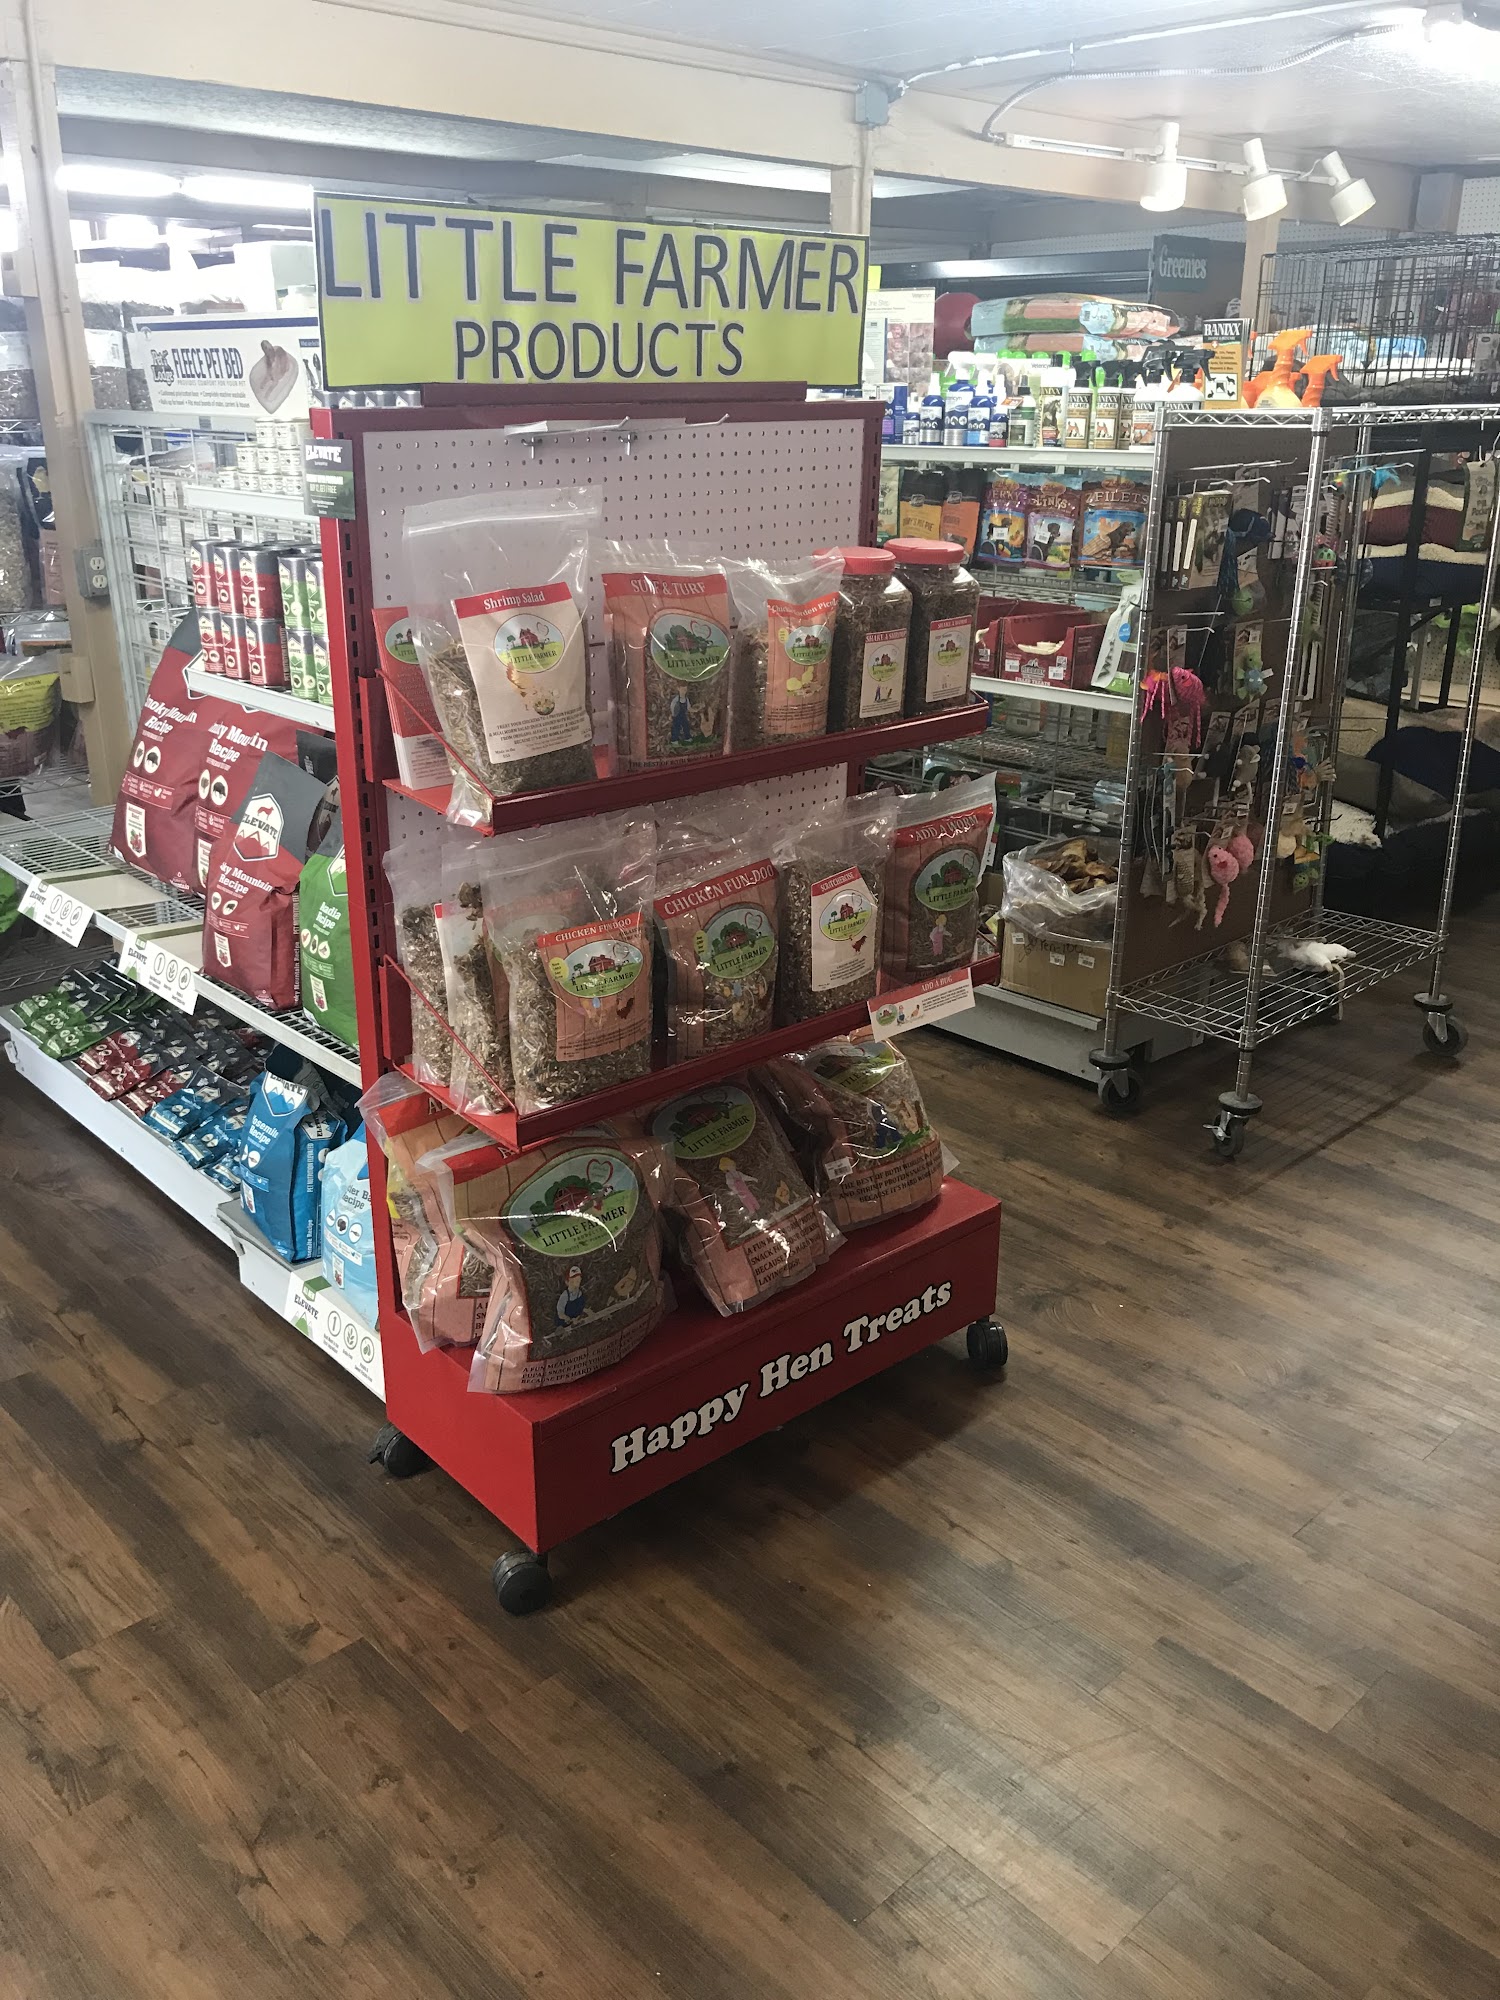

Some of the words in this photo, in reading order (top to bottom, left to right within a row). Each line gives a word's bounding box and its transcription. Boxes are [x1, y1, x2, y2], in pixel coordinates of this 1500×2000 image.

[321, 208, 577, 302] LITTLE
[615, 228, 860, 315] FARMER
[1159, 244, 1207, 279] Greenies
[1203, 322, 1241, 336] BANIXX
[455, 320, 744, 381] PRODUCTS
[171, 348, 206, 379] FLEECE
[206, 347, 224, 379] PET
[223, 347, 244, 379] BED
[662, 582, 672, 595] &
[672, 582, 706, 596] TURF
[483, 596, 521, 610] Shrimp
[521, 591, 545, 604] Salad
[866, 634, 884, 642] SHAKE
[511, 654, 533, 664] LITTLE
[533, 650, 557, 660] FARMER
[690, 655, 721, 666] FARMER
[209, 738, 241, 763] Recipe
[240, 813, 279, 841] ELEVATE
[915, 826, 938, 841] ADD
[940, 823, 949, 834] A
[948, 814, 979, 833] WORM
[218, 873, 250, 895] Recipe
[232, 866, 273, 893] Mountain
[664, 883, 724, 915] CHICKEN
[723, 864, 775, 893] FUN-DOO
[928, 891, 952, 903] LITTLE
[555, 926, 597, 942] CHICKEN
[829, 924, 848, 935] LITTLE
[847, 917, 866, 930] FARMER
[128, 948, 147, 965] ELEVATE
[716, 955, 743, 972] LITTLE
[741, 946, 768, 963] FARMER
[604, 971, 634, 984] FARMER
[921, 984, 934, 992] ADD
[940, 975, 953, 985] BUG
[249, 1126, 272, 1145] Recipe
[688, 1130, 719, 1153] LITTLE
[717, 1115, 750, 1136] FARMER
[307, 1142, 315, 1164] ELEVATED
[841, 1182, 855, 1190] THE
[856, 1176, 874, 1187] BEST
[874, 1172, 885, 1180] OF
[884, 1168, 902, 1177] BOTH
[840, 1191, 855, 1199] AND
[856, 1183, 883, 1196] SHRIMP
[859, 1190, 890, 1202] BECAUSE
[890, 1185, 902, 1193] IT'S
[901, 1179, 918, 1190] HARD
[542, 1224, 582, 1247] LITTLE
[752, 1240, 766, 1252] FUN
[750, 1249, 774, 1265] SNACK
[754, 1254, 785, 1276] BECAUSE
[294, 1294, 319, 1320] ELEVATE
[521, 1375, 554, 1384] BECAUSE
[571, 1367, 592, 1378] HARD
[530, 1364, 546, 1372] FUN
[548, 1366, 573, 1376] SNACK
[573, 1362, 588, 1371] FOR
[611, 1383, 750, 1473] Happy
[759, 1338, 833, 1397] Hen
[843, 1280, 952, 1354] Treats
